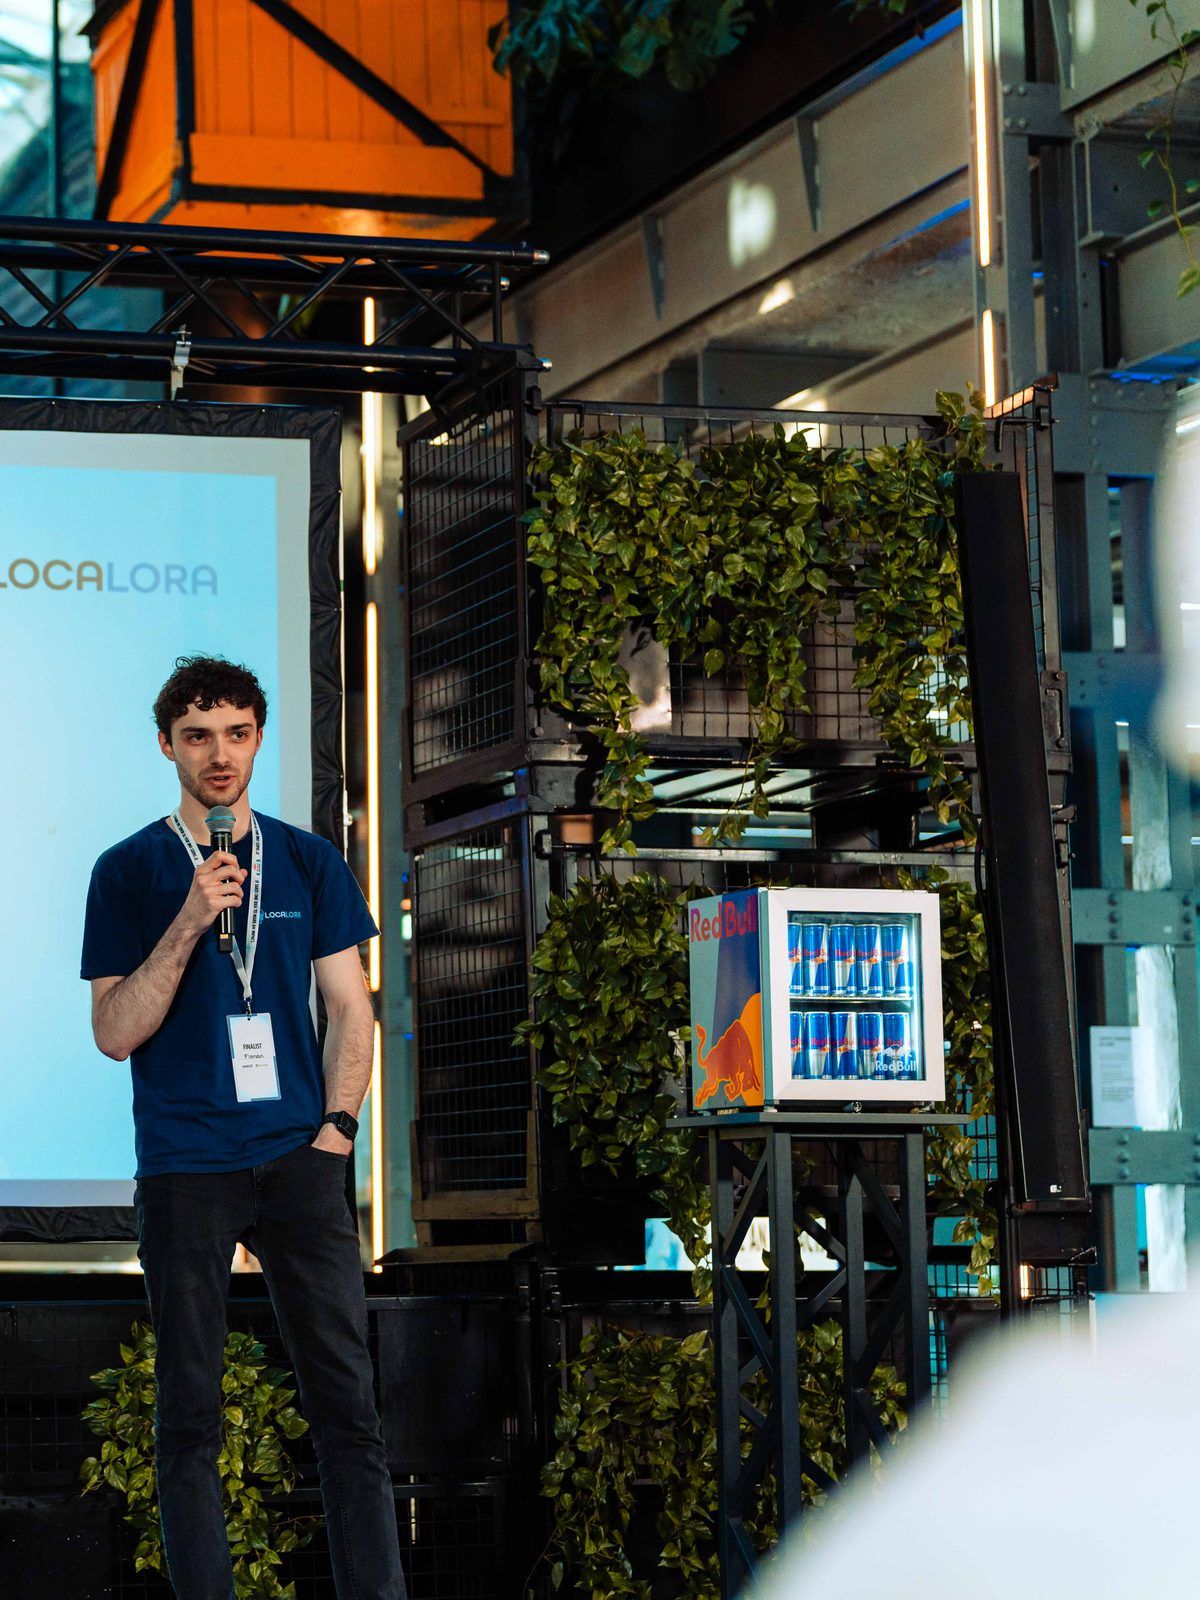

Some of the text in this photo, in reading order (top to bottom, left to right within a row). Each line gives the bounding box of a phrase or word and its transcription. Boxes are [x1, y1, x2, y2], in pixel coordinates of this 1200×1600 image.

[690, 894, 757, 943] Red Bull
[876, 1060, 917, 1072] Red Bull
